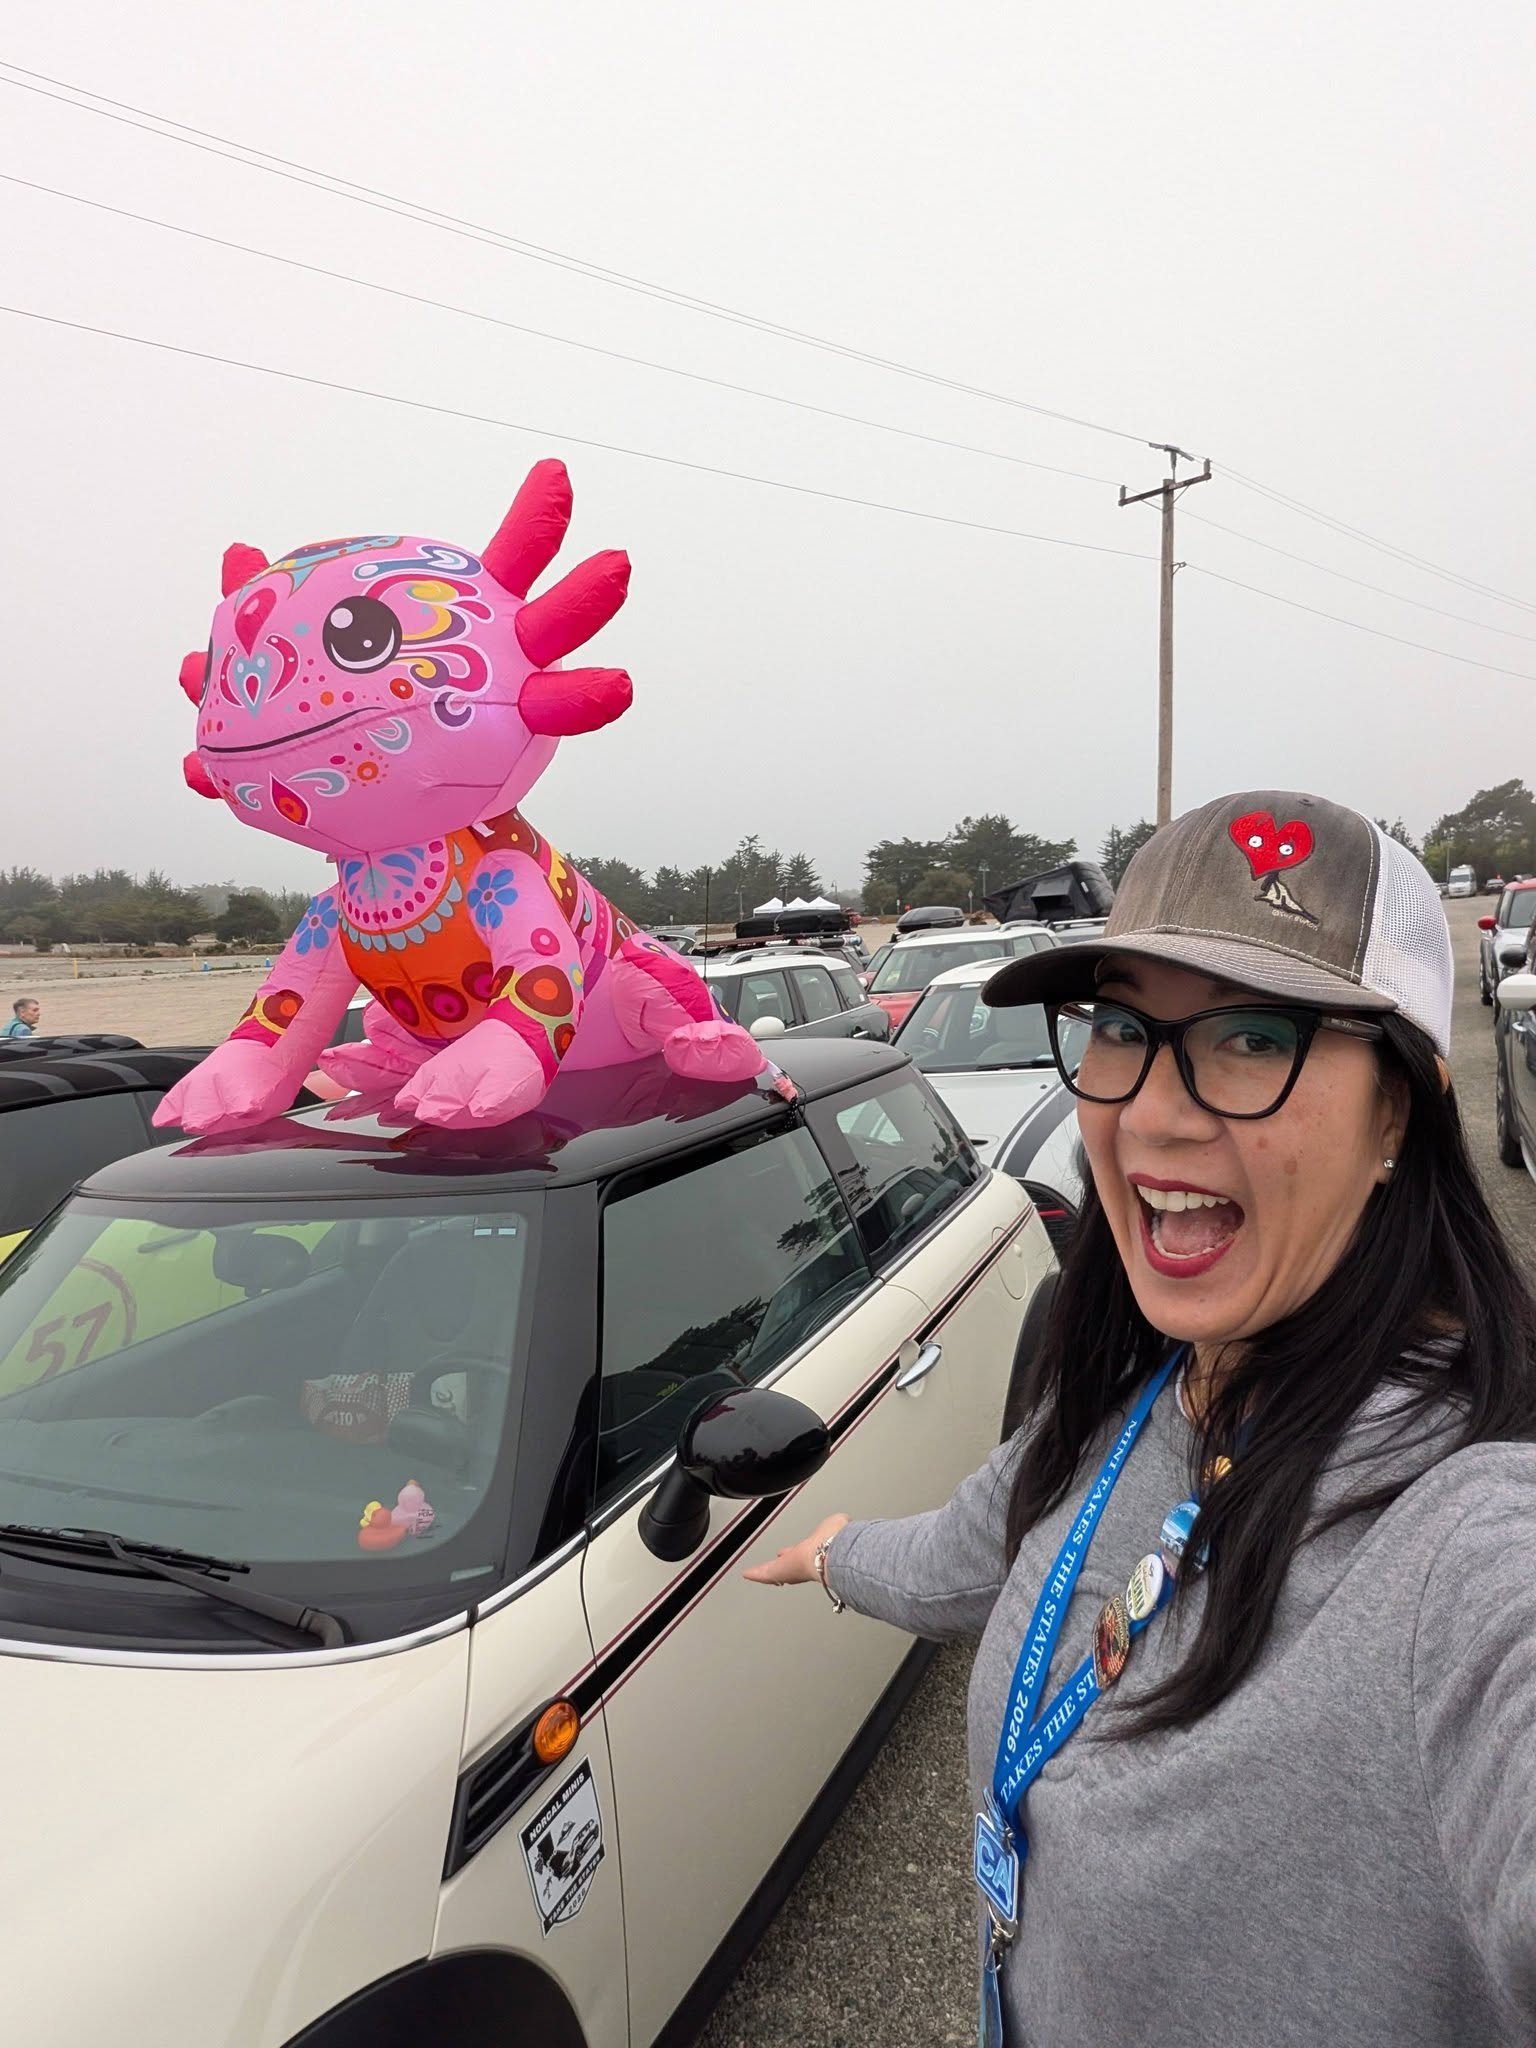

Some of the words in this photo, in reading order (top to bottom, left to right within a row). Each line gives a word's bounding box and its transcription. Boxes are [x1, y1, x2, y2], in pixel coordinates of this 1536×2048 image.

[19, 1301, 113, 1385] 57
[1108, 1420, 1137, 1470] MINI
[1072, 1475, 1111, 1545] TAKES
[1050, 1550, 1077, 1599] THE
[1022, 1599, 1057, 1689] STATES
[1000, 1738, 1043, 1804] TAKES
[1043, 1695, 1076, 1742] THE
[1007, 1690, 1029, 1753] 2026
[529, 1800, 562, 1843] NORCAL
[562, 1772, 586, 1803] MINIS
[549, 1899, 566, 1924] TAKE
[565, 1884, 577, 1901] THE
[977, 1835, 1010, 1911] CA
